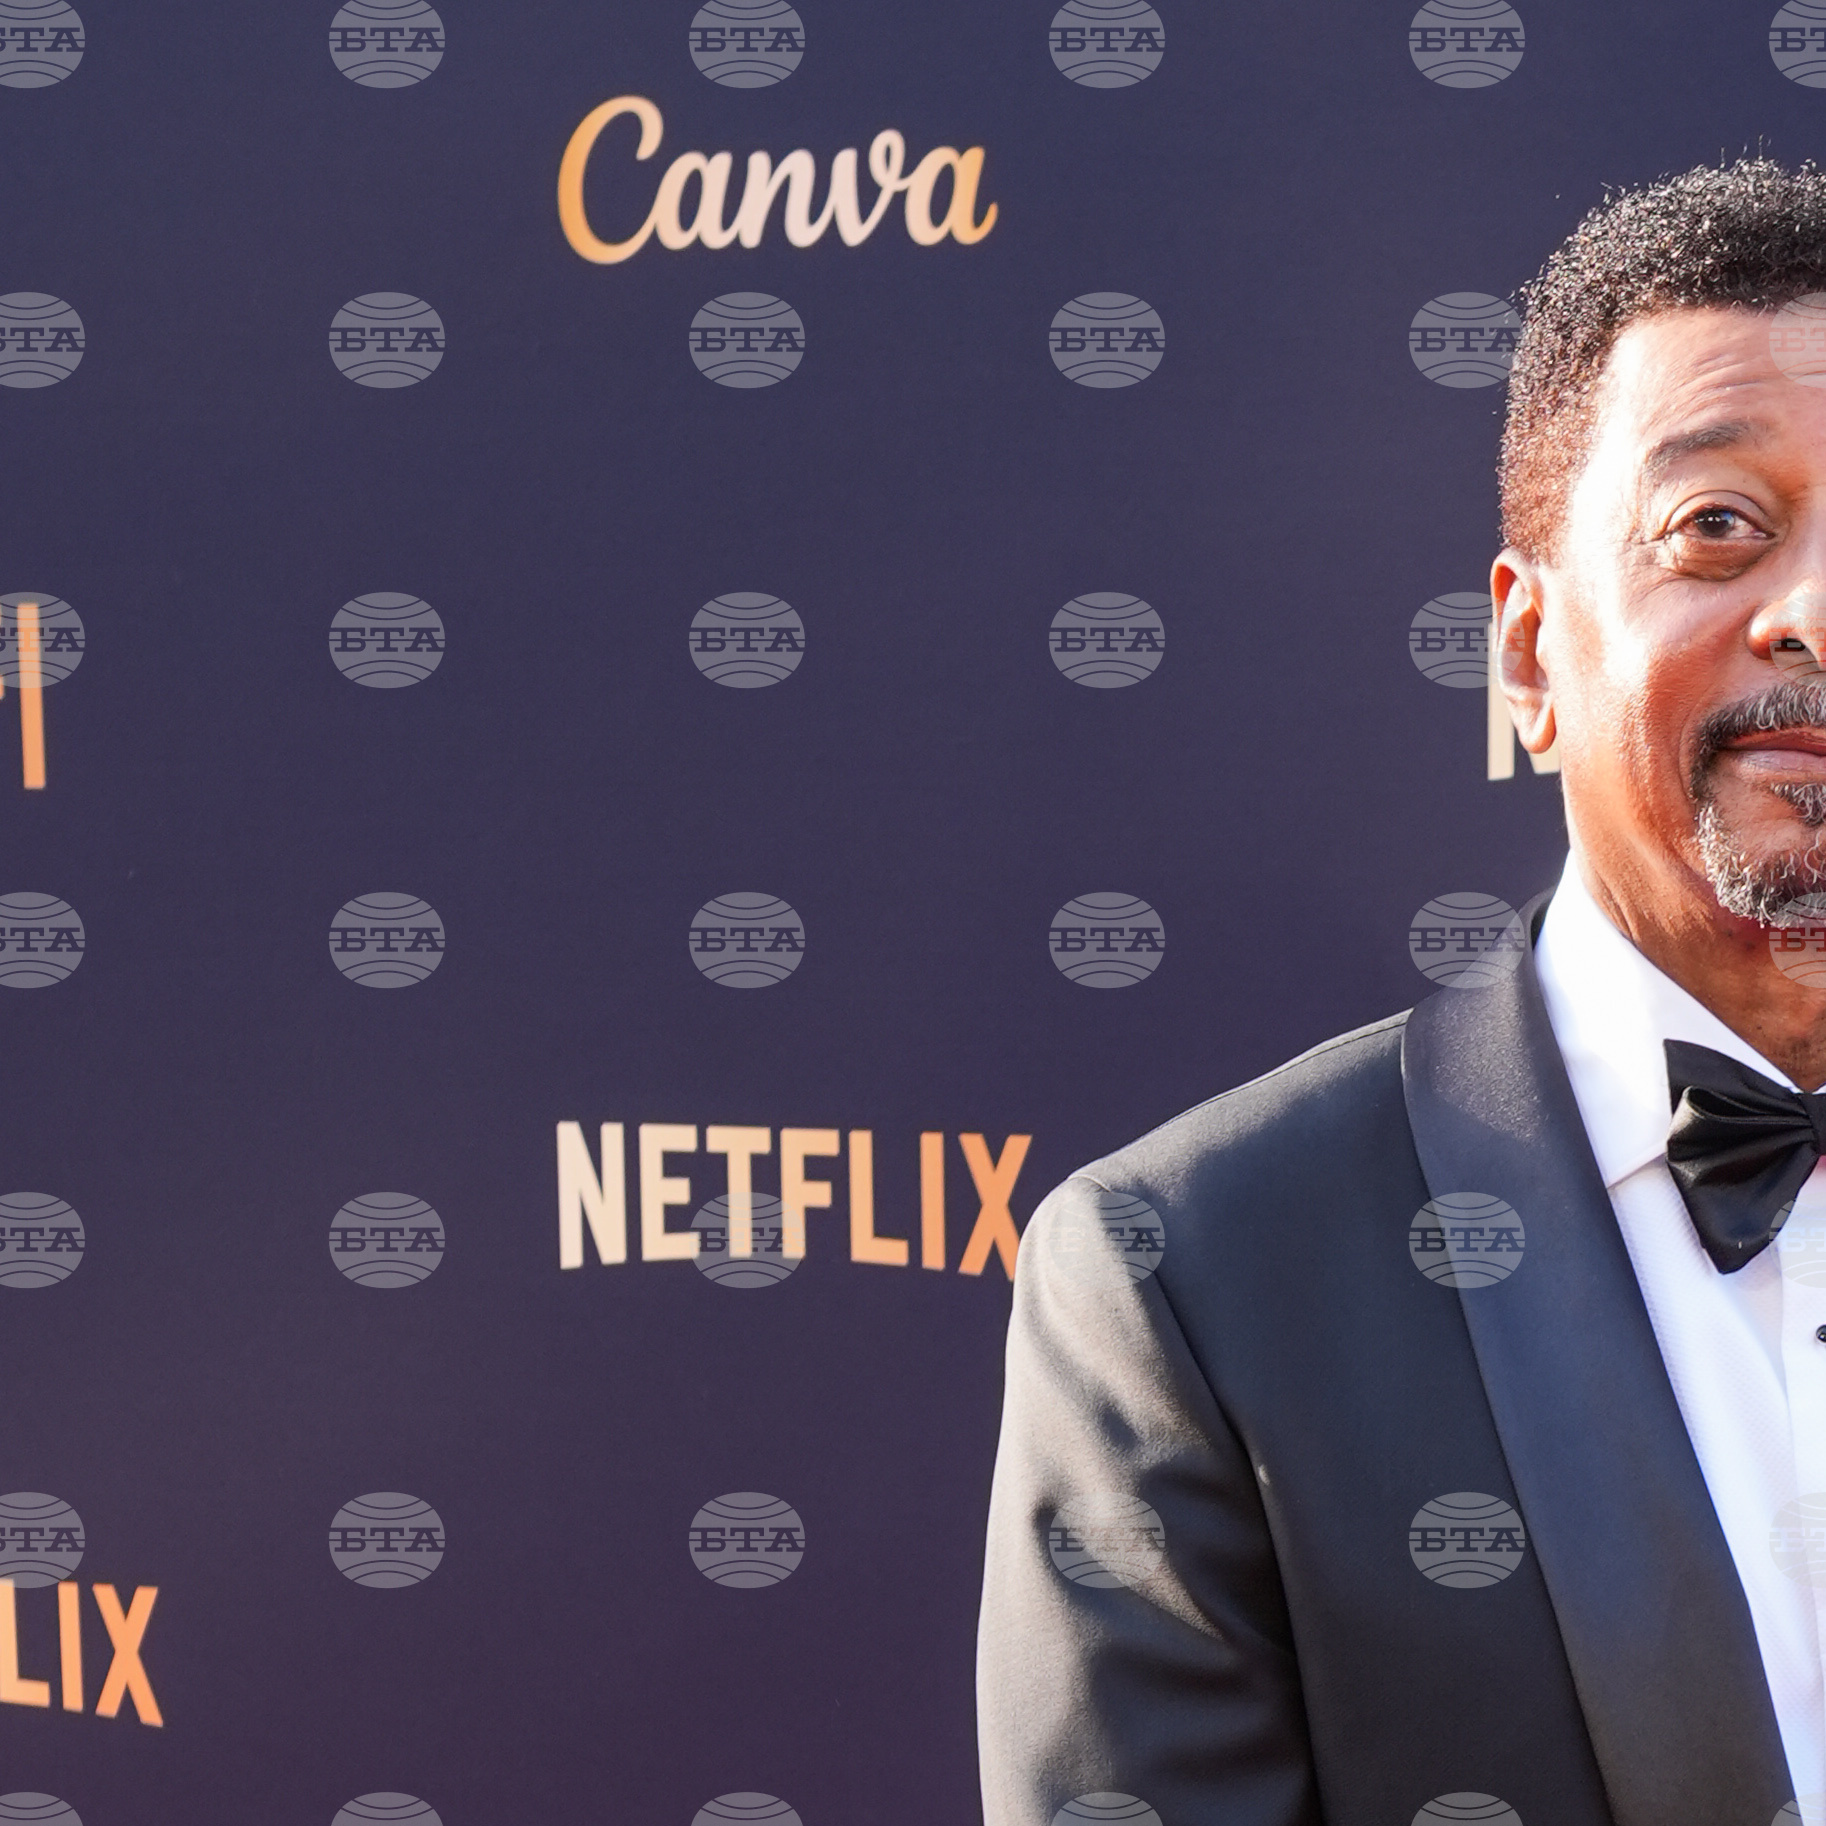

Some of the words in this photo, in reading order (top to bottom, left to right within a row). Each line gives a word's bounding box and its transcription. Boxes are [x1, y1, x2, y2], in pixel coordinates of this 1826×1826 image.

[558, 95, 999, 265] Canva
[0, 603, 46, 789] I
[557, 1121, 1033, 1282] NETFLIX
[0, 1578, 163, 1728] LIX
